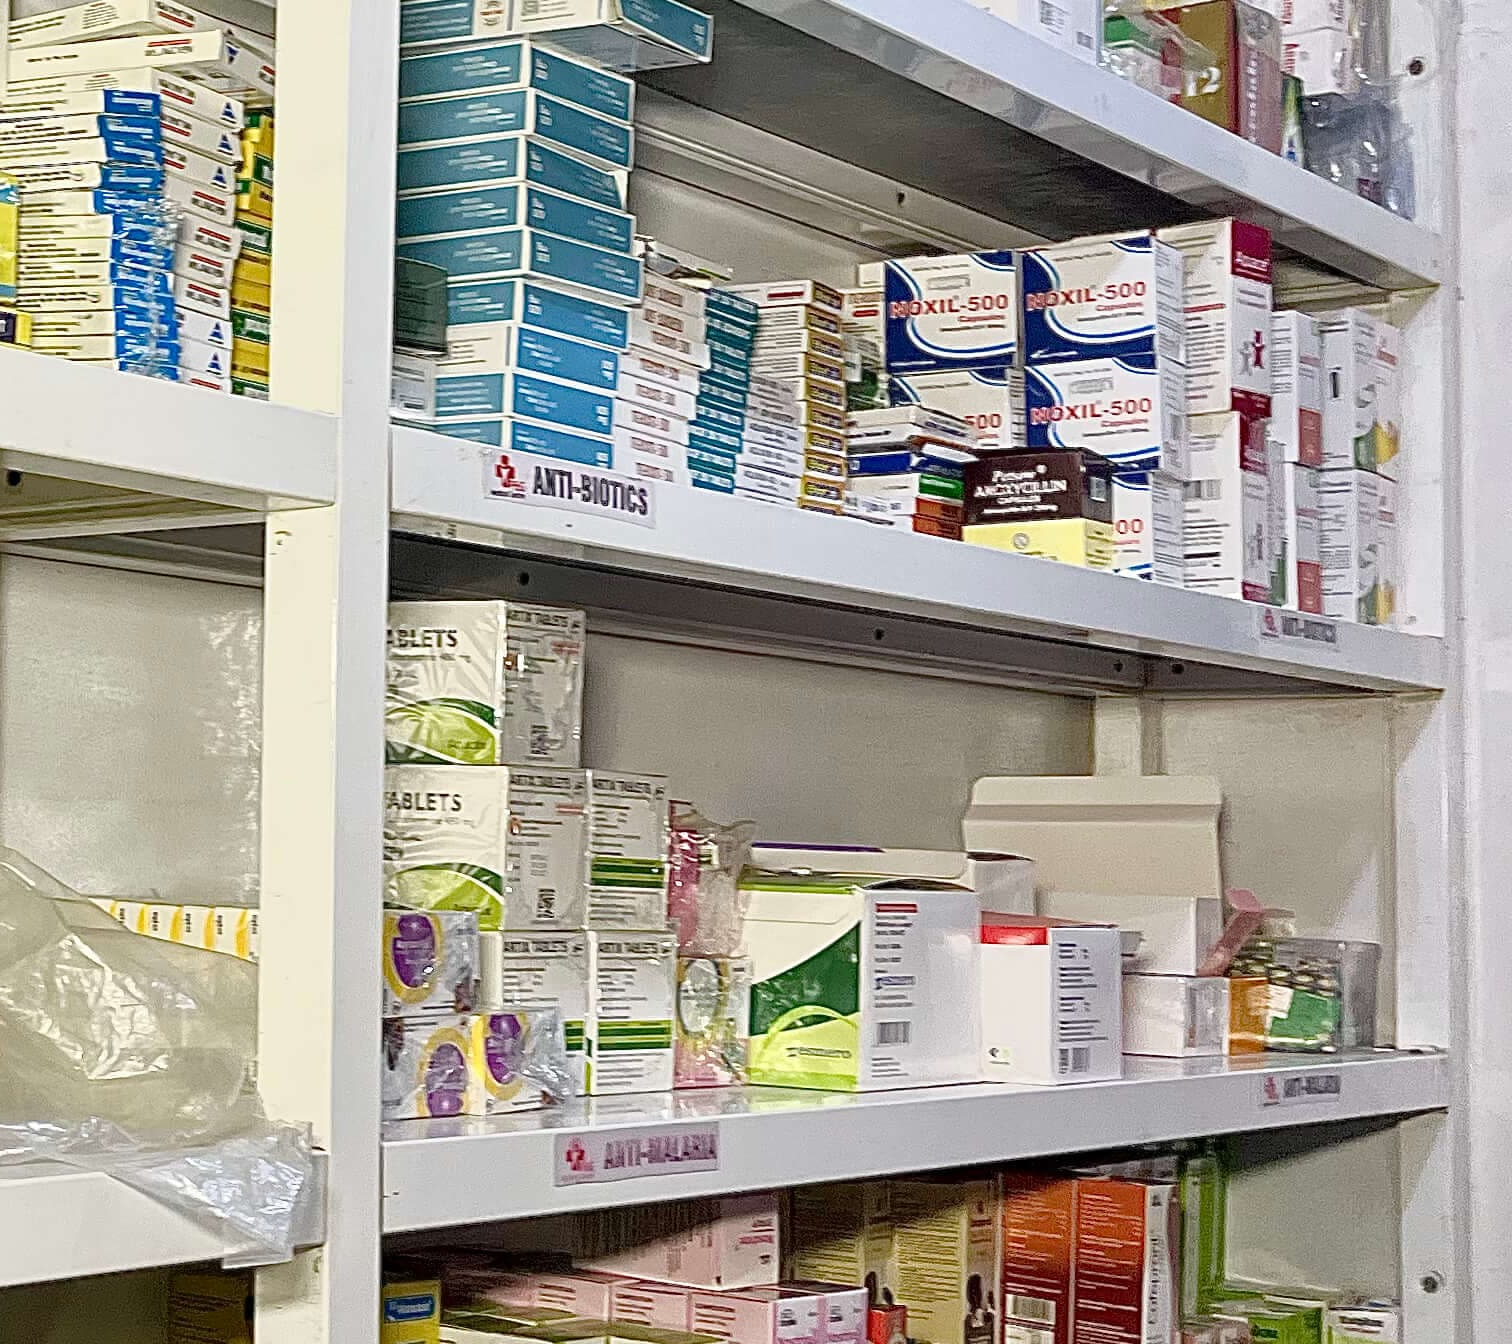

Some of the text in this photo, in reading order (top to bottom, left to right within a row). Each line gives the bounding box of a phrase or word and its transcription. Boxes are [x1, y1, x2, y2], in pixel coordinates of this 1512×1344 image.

[533, 465, 649, 516] ANTI-BIOTICS
[386, 628, 459, 649] ABLETS
[385, 792, 463, 813] ABLETS
[603, 1132, 719, 1171] ANTI-MALARIA
